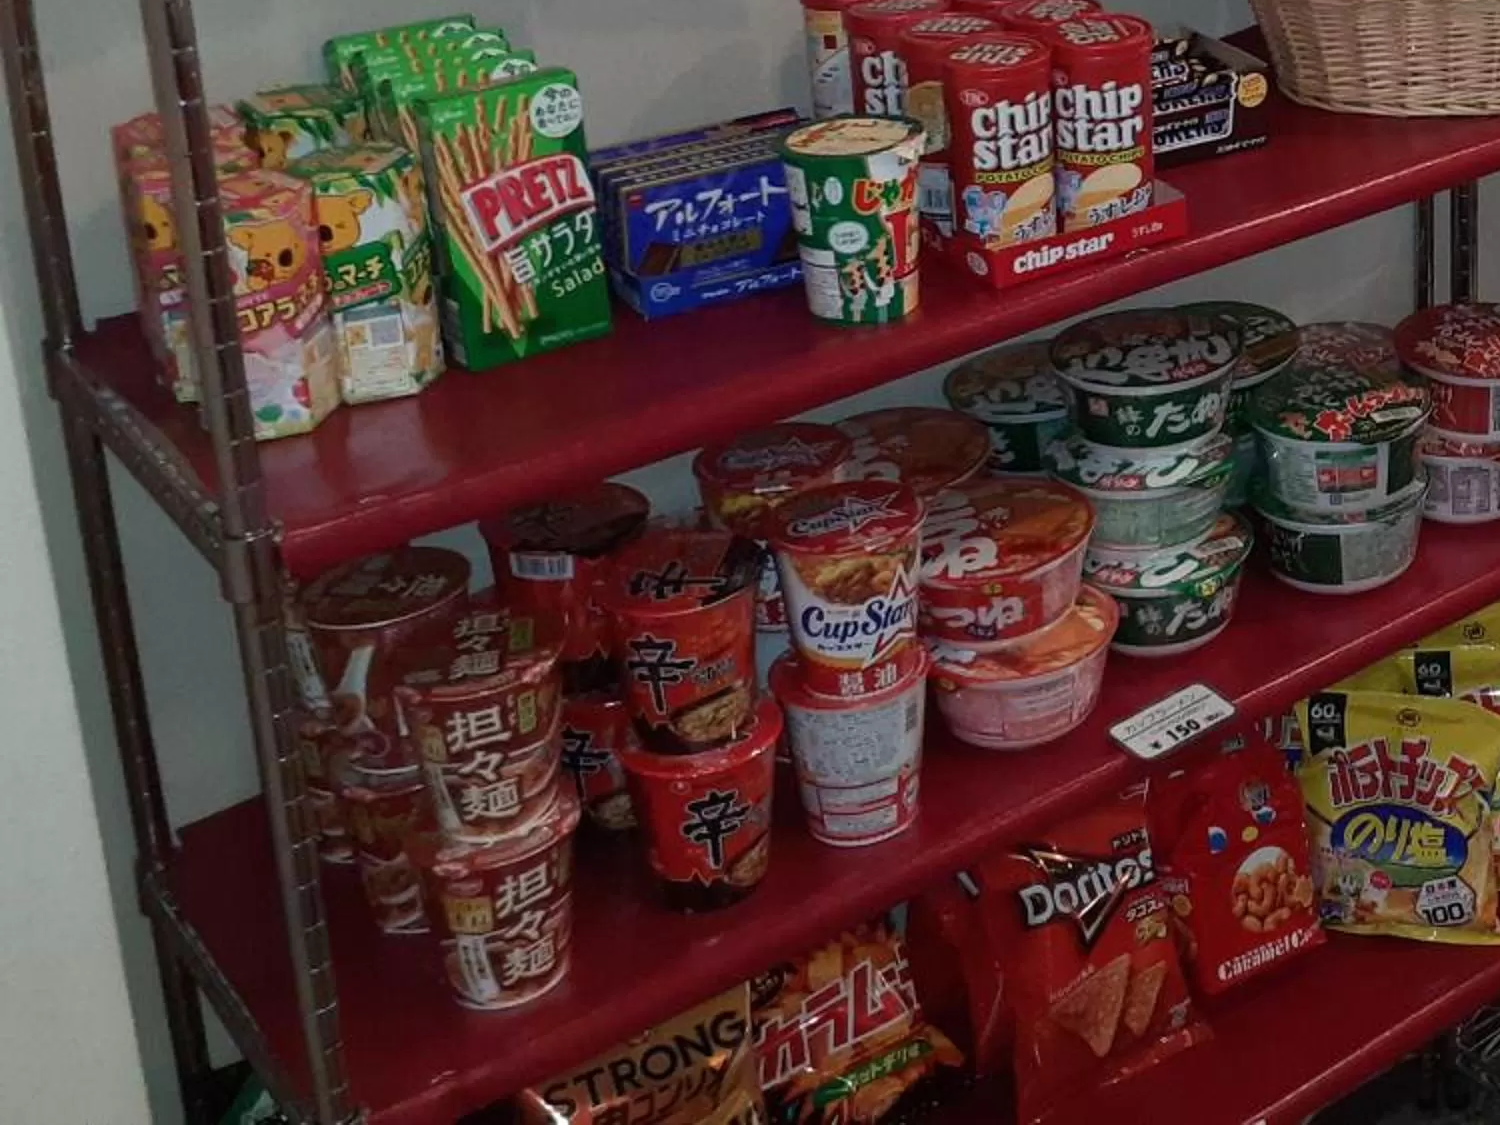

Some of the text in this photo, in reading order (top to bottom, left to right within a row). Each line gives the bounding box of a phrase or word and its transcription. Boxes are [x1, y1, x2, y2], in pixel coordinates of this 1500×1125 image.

[861, 51, 909, 88] ch
[864, 86, 906, 117] st
[970, 91, 1052, 139] chip
[1055, 81, 1142, 121] chip
[1057, 115, 1144, 151] star
[471, 158, 587, 241] PRETZ
[643, 175, 788, 233] アルフォート
[504, 207, 597, 284] 旨サラダ
[1012, 231, 1116, 275] chip star
[551, 257, 606, 299] Salad
[922, 594, 1026, 631] つね
[1165, 718, 1202, 742] 150
[445, 704, 523, 824] 担々麺
[1343, 812, 1448, 861] のり塩
[494, 862, 557, 988] 担々麺
[1421, 901, 1465, 925] 100
